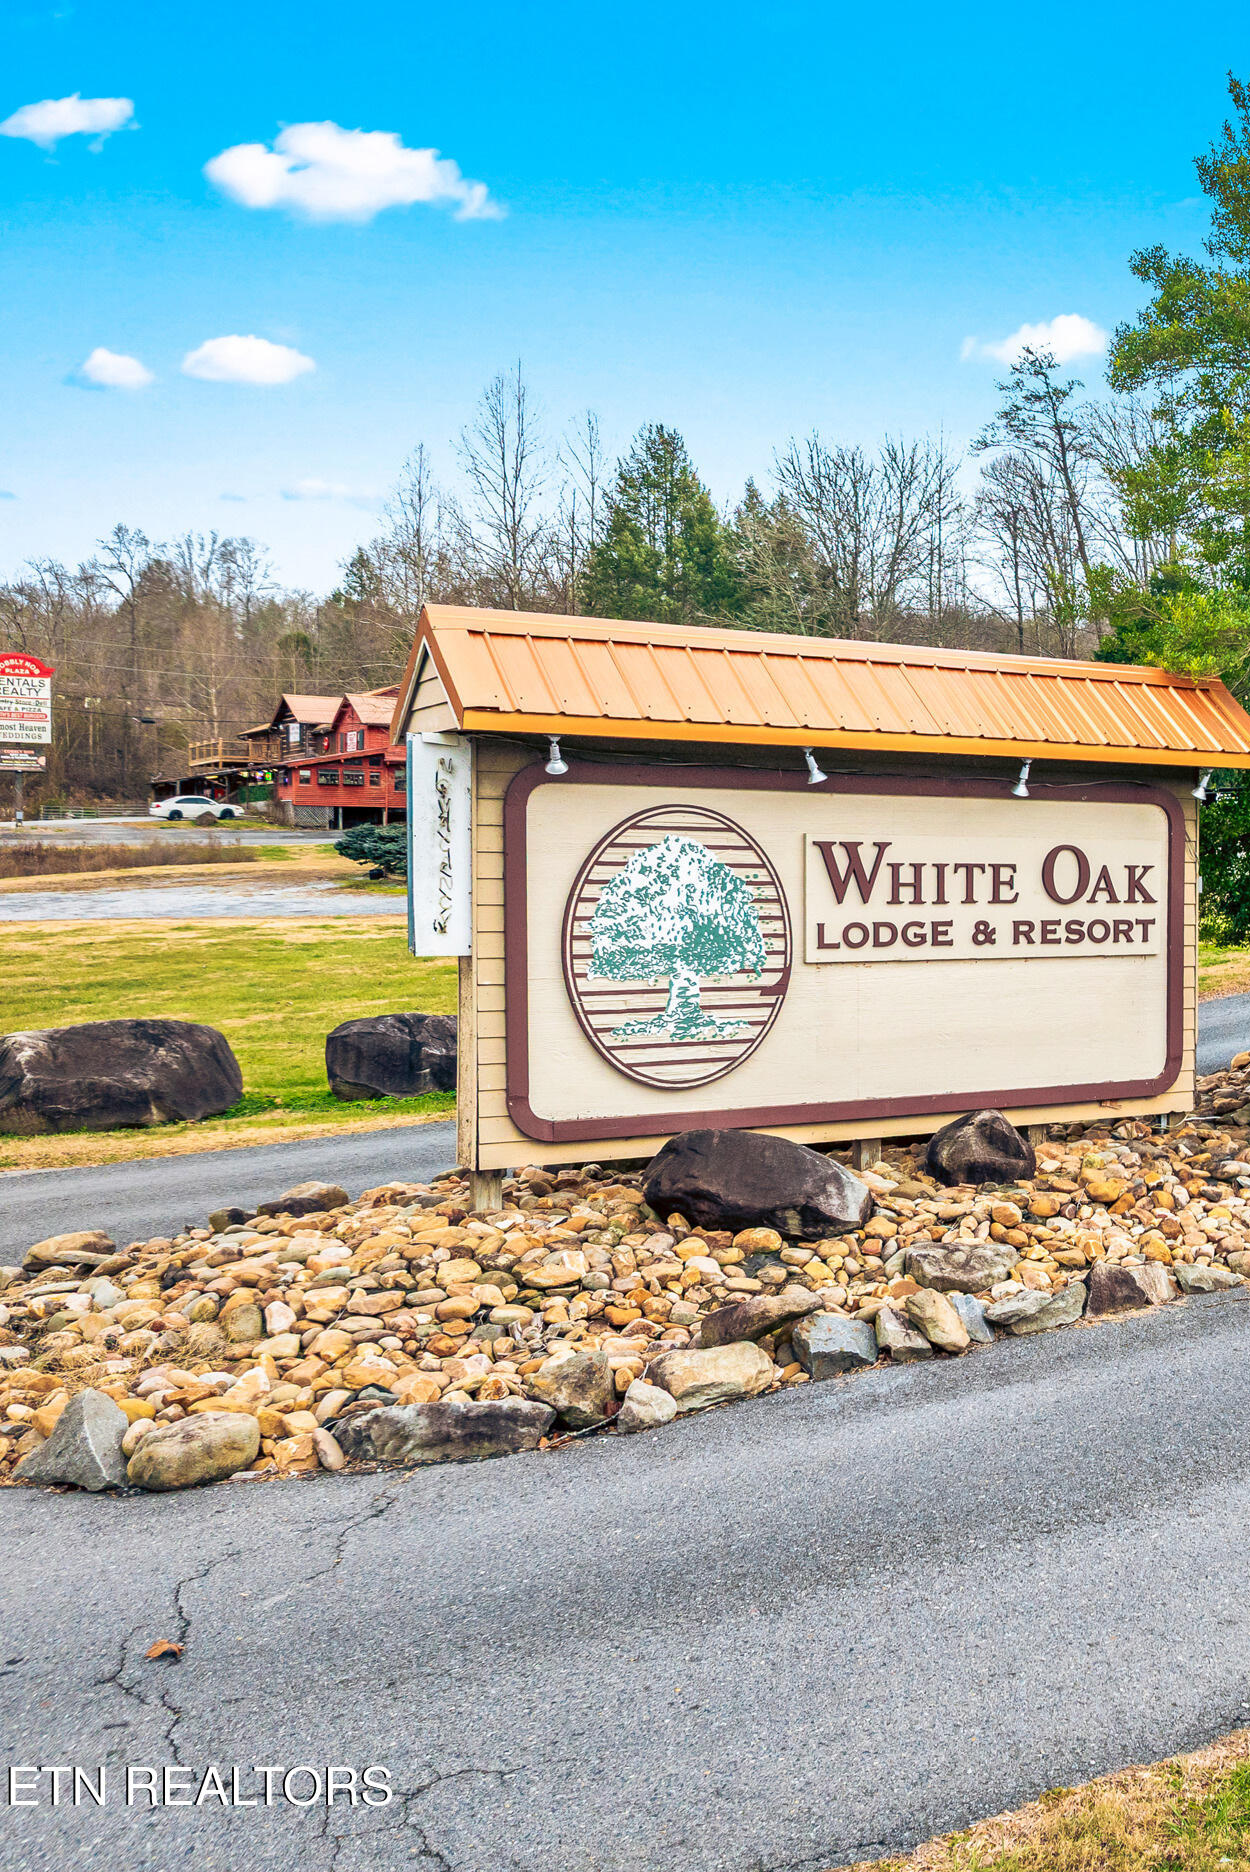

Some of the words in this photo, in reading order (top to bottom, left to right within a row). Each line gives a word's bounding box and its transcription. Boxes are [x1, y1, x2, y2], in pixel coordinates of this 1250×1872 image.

[0, 659, 24, 669] OBBLY
[24, 661, 40, 675] NOB
[0, 677, 45, 687] ENTALS
[19, 723, 47, 732] Heaven
[813, 841, 1019, 905] WHITE
[1041, 844, 1158, 905] OAK
[816, 920, 954, 950] LODGE
[971, 919, 997, 946] &
[1012, 918, 1156, 945] RESORT
